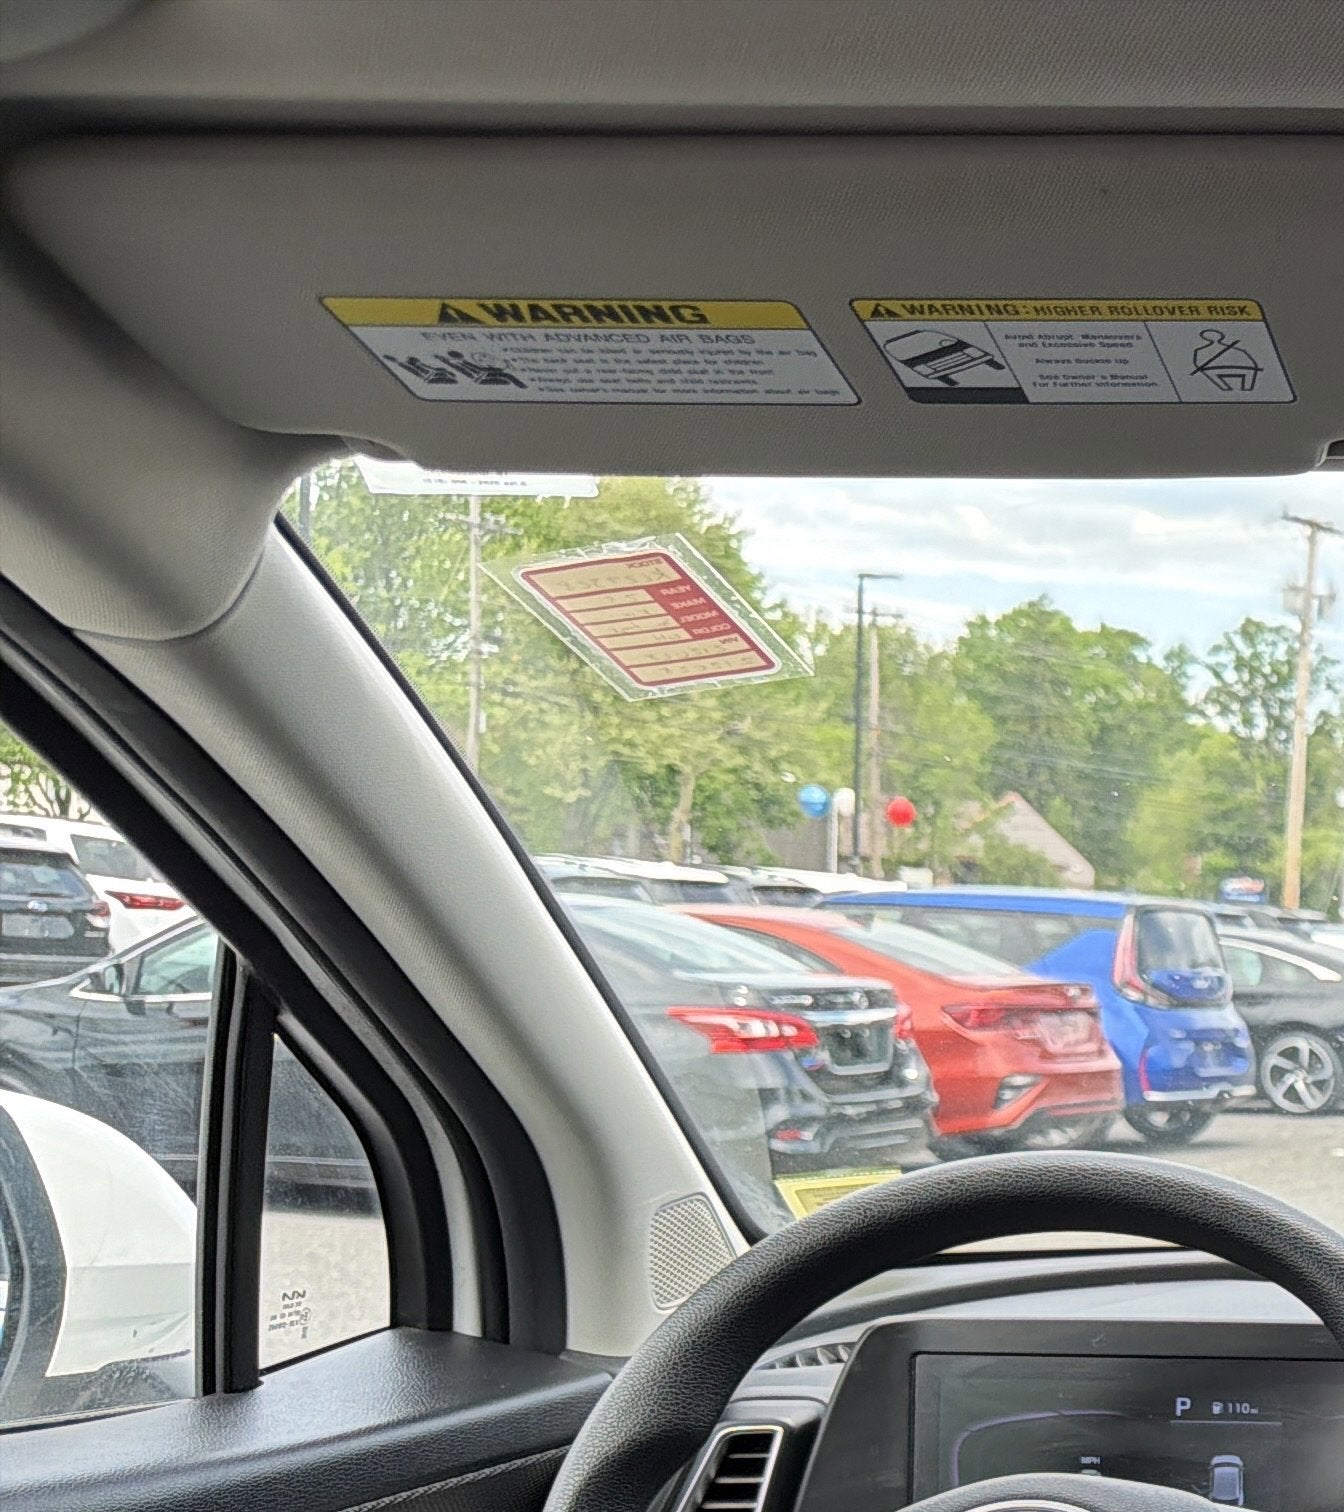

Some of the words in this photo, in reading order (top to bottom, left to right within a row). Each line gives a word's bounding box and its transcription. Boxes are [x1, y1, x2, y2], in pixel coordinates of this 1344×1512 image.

[477, 303, 710, 323] WARNING
[1034, 305, 1102, 317] HIGHER
[1106, 306, 1201, 317] ROLLOVER
[1204, 306, 1251, 318] RISK
[421, 332, 476, 341] EVEN
[482, 332, 536, 341] WITH
[544, 332, 649, 343] ADVANCED
[660, 333, 692, 344] AIR
[698, 333, 755, 345] BAGS
[1175, 1397, 1191, 1416] P
